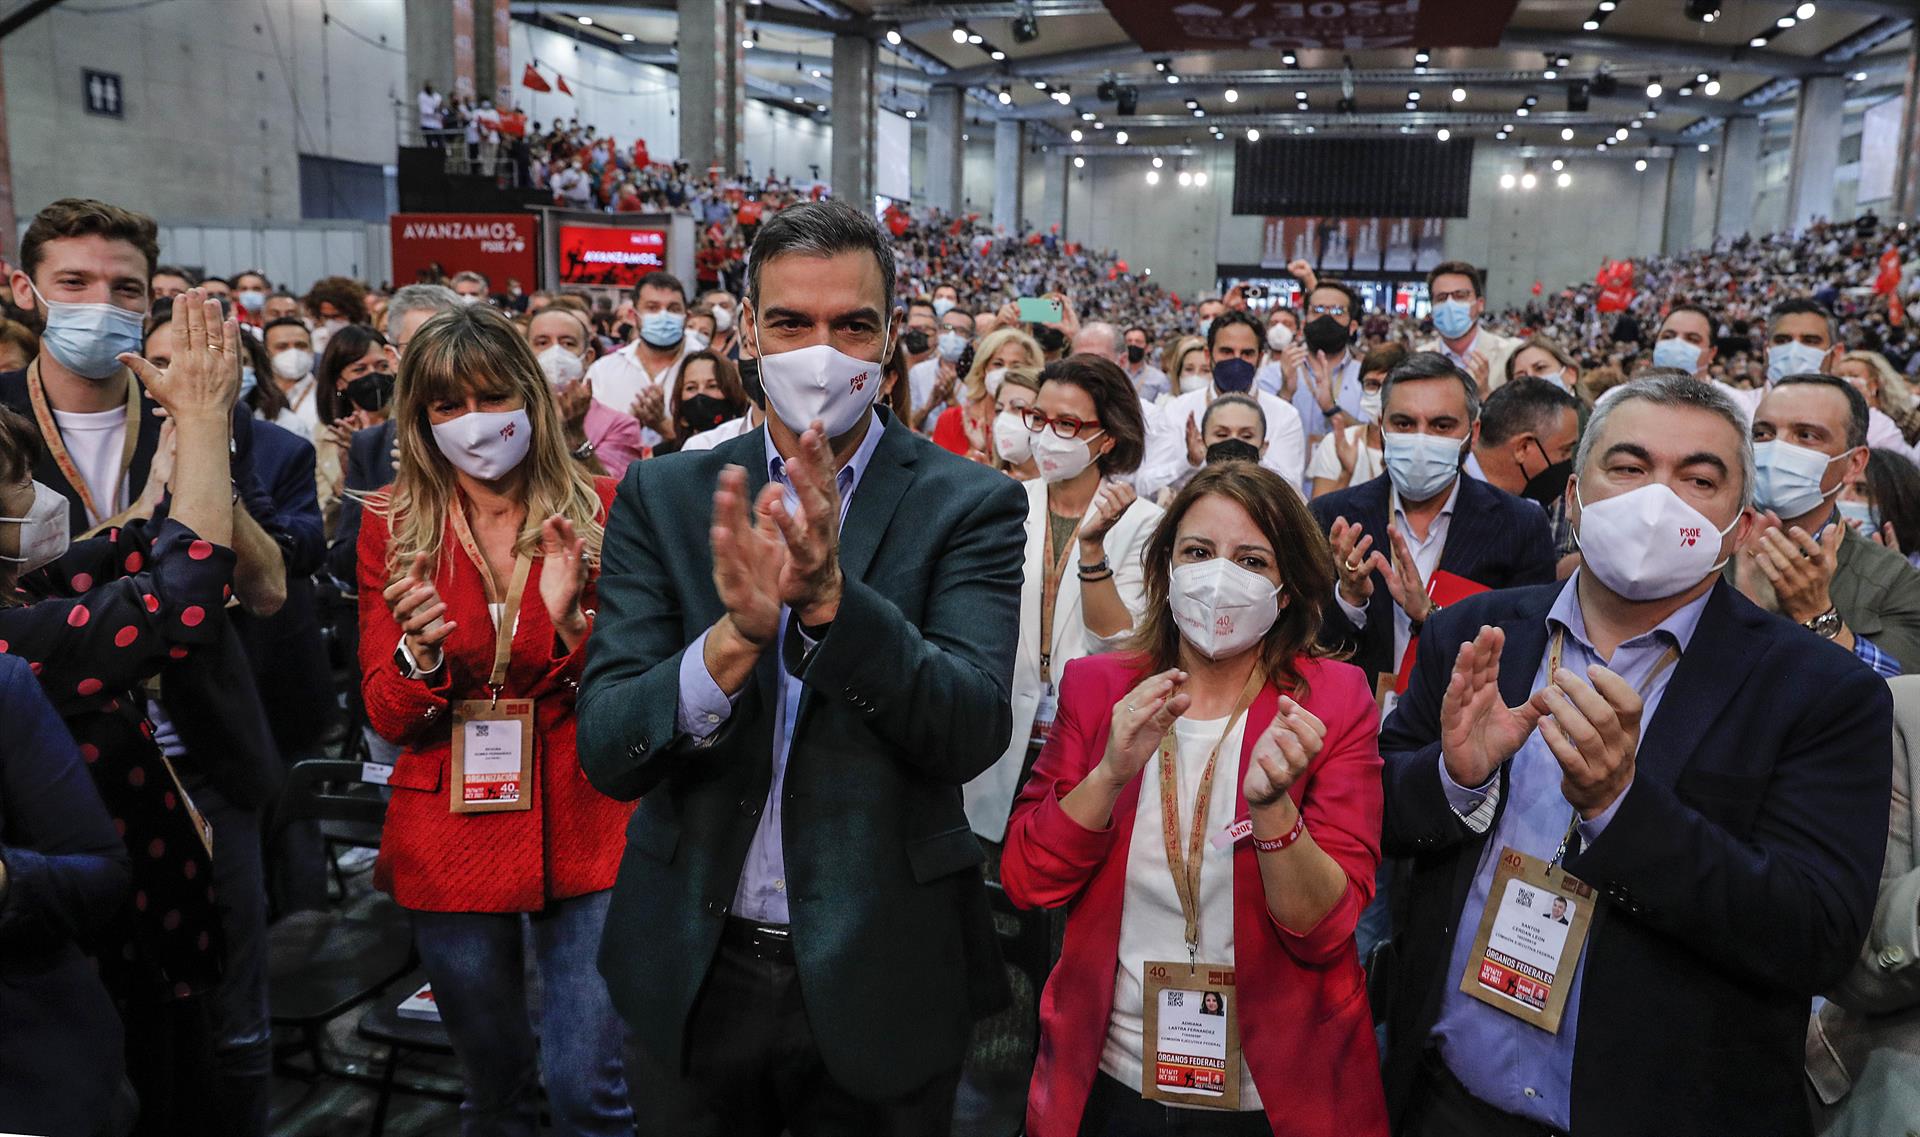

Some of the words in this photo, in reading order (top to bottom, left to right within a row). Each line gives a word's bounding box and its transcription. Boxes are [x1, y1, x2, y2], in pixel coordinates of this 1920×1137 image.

[850, 371, 868, 386] PSOE
[1680, 527, 1701, 537] PSOE
[1216, 615, 1230, 626] 40
[500, 783, 515, 792] 40
[1504, 853, 1521, 868] 40
[1150, 966, 1166, 978] 40
[1486, 948, 1516, 969] ÓRGANOS
[1516, 959, 1554, 985] FEDERALES
[1158, 1052, 1188, 1065] ÓRGANOS
[1189, 1057, 1225, 1069] FEDERALES
